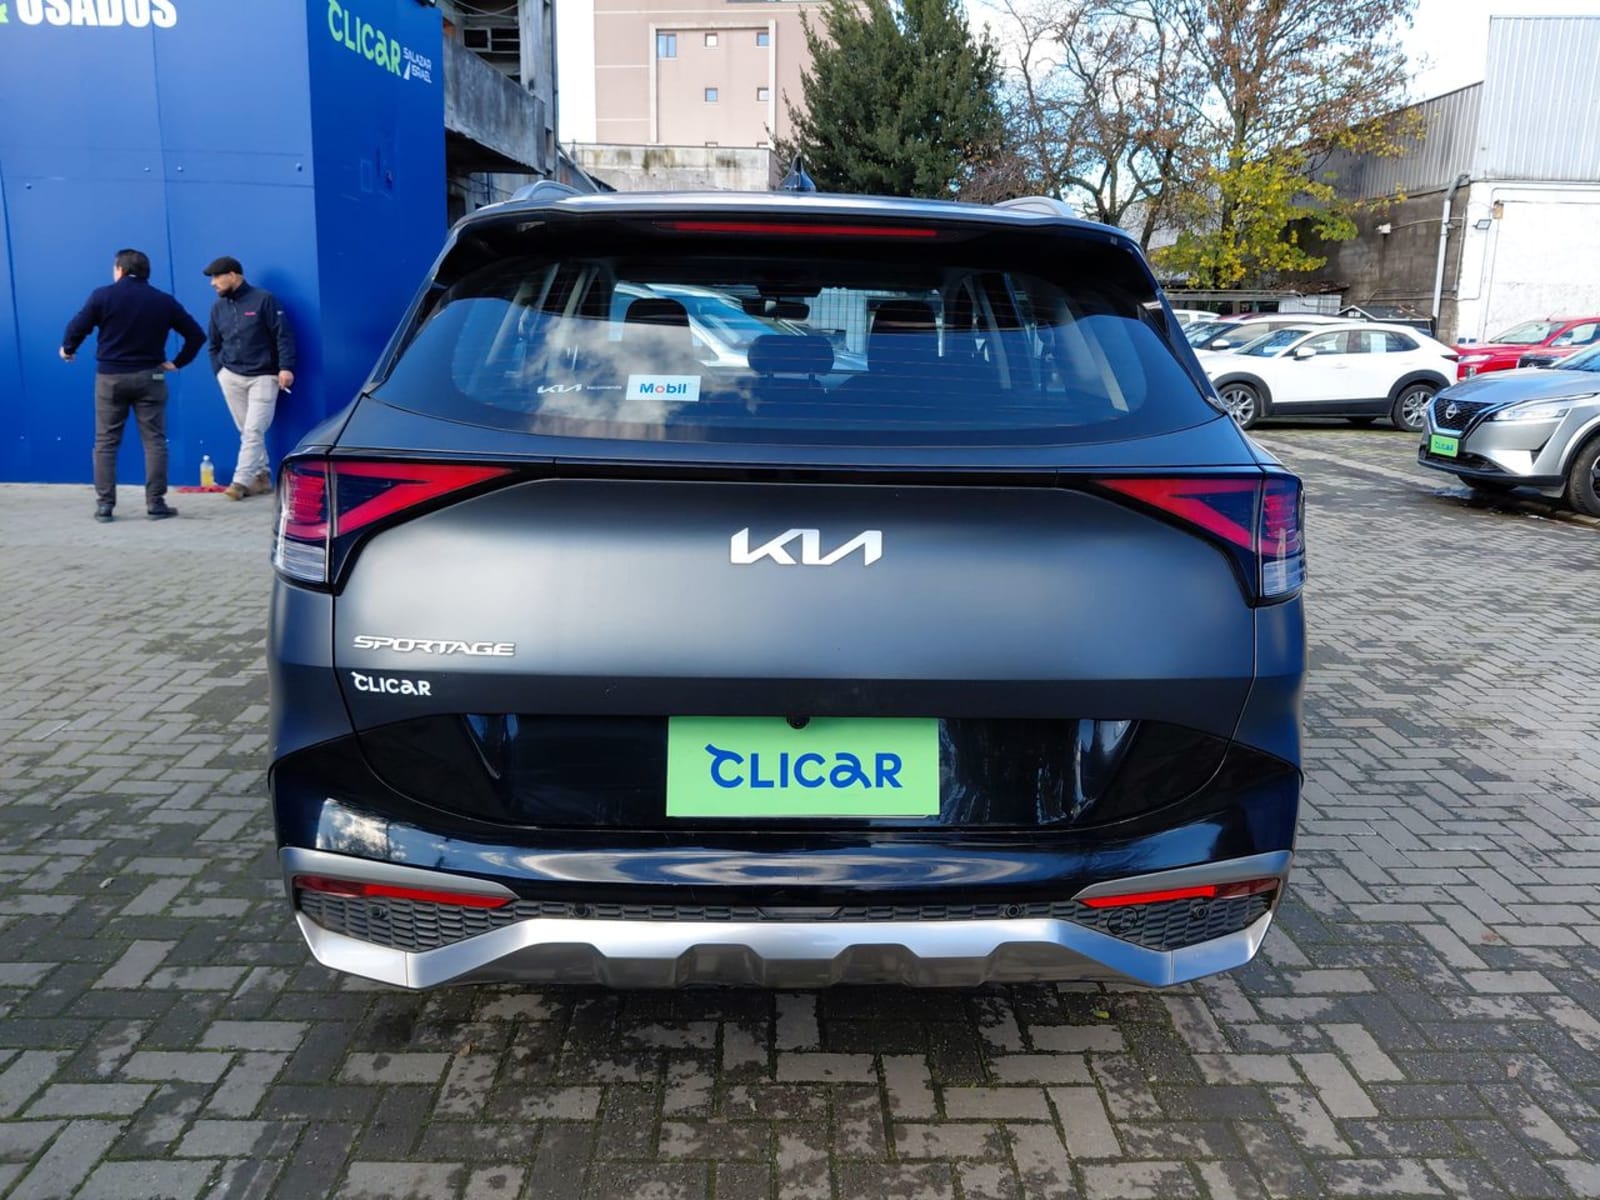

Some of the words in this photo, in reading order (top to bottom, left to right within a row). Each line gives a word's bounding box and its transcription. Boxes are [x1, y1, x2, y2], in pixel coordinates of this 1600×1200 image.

[639, 383, 687, 394] Mobil
[730, 527, 882, 566] KIA
[353, 635, 516, 656] SPORTAGE
